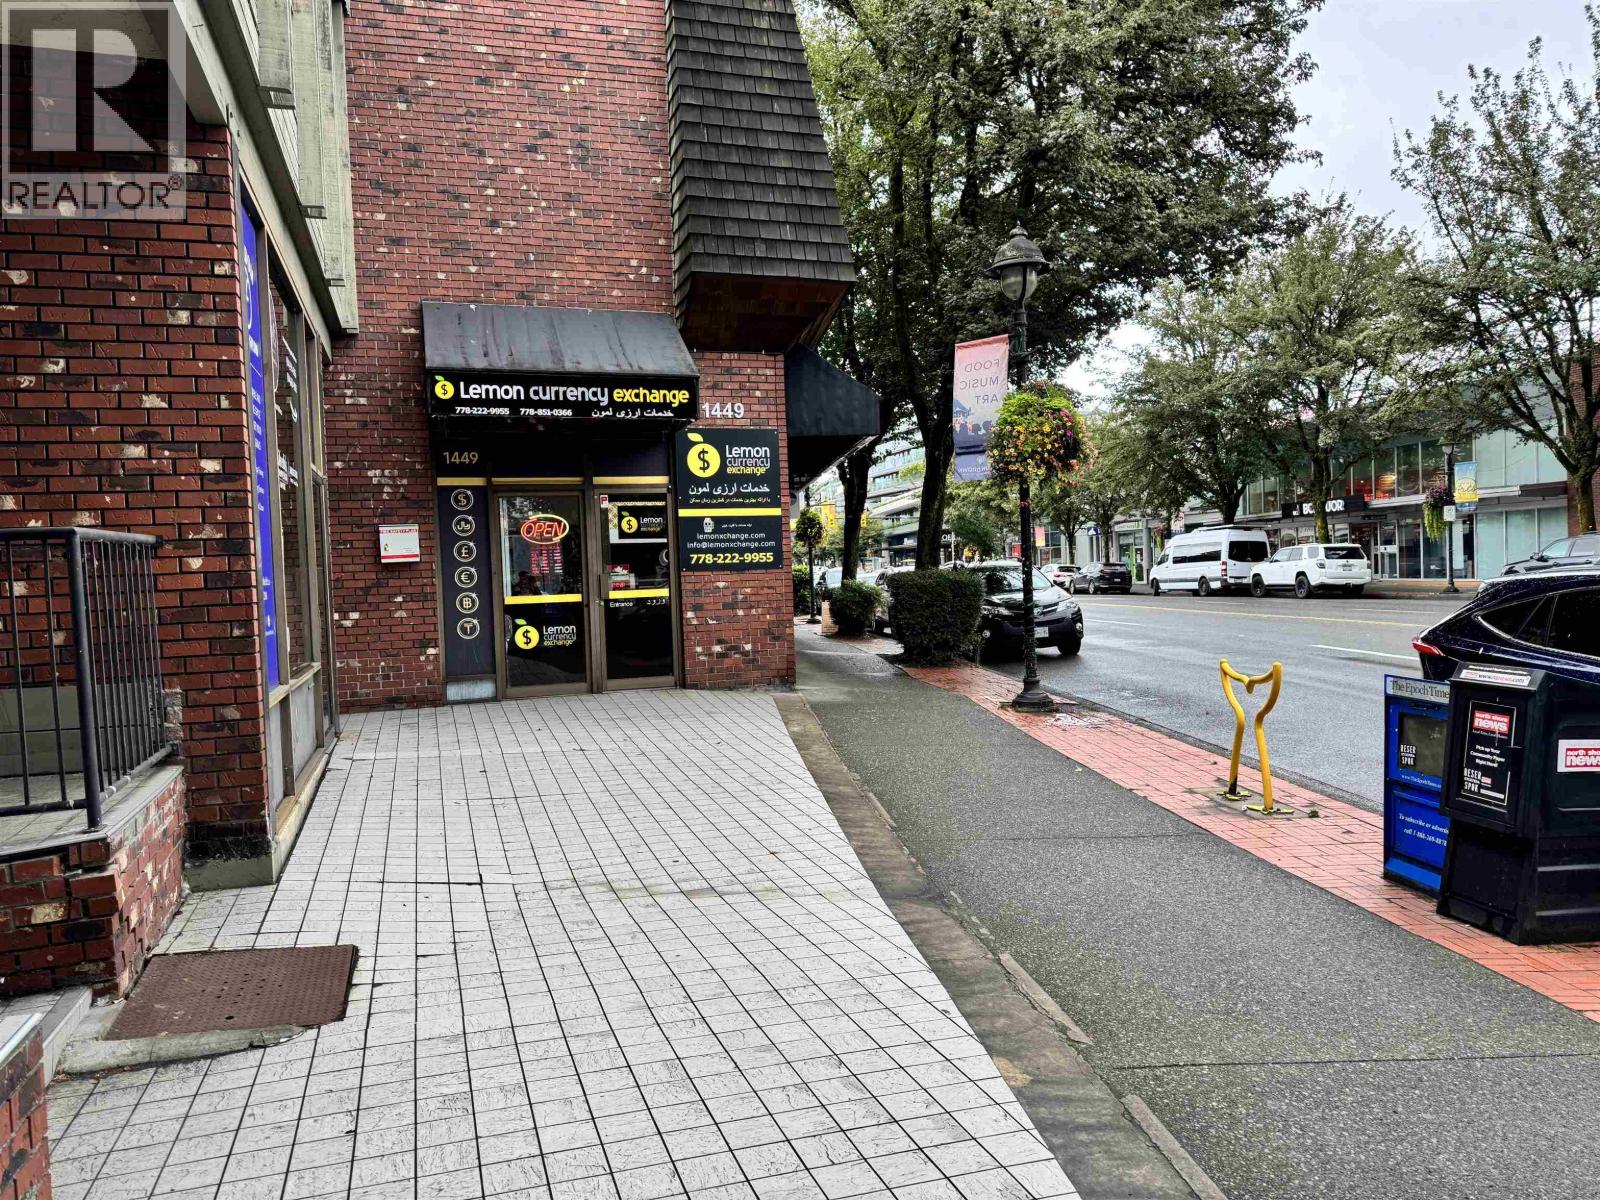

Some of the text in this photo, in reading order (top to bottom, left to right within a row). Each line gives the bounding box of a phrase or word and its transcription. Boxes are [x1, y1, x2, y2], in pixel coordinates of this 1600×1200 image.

[460, 381, 525, 400] Lemon
[529, 385, 608, 406] currency
[612, 387, 690, 407] exchange
[455, 406, 573, 416] 778-222-9955 778-851-0366
[591, 407, 674, 419] خدمات ارزی لمون
[702, 402, 745, 418] 1449
[725, 445, 770, 458] Lemon
[443, 451, 479, 465] 1449
[726, 457, 770, 469] currency
[727, 466, 766, 476] exchange
[688, 482, 770, 495] خدمات ارزی لمون
[640, 516, 663, 524] Lemon
[523, 522, 564, 538] OPEN
[697, 533, 766, 541] lemonxchange.com
[687, 541, 776, 549] info@lemonxchange.com
[690, 552, 774, 564] 778-222-9955
[543, 625, 576, 635] Lemon
[543, 633, 577, 642] currency
[1391, 680, 1450, 698] The Epoch Time
[1474, 718, 1508, 731] news
